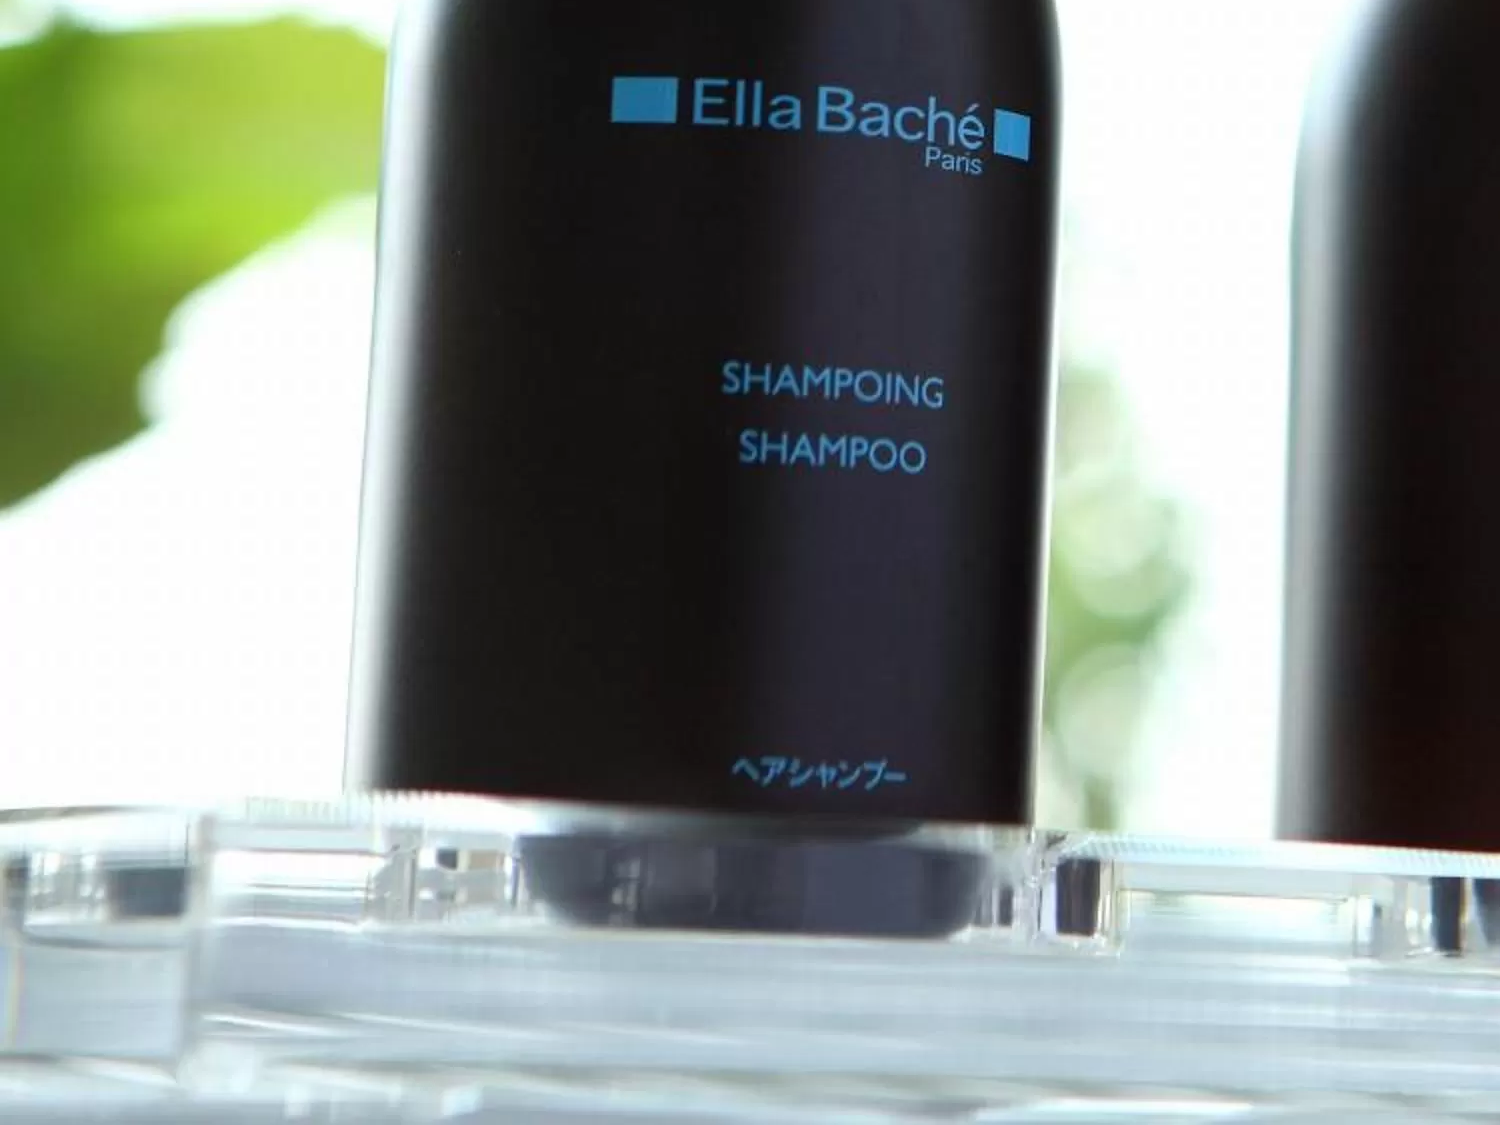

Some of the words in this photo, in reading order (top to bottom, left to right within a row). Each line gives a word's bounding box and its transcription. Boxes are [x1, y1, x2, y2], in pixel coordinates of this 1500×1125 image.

[692, 77, 802, 131] Ella
[816, 84, 986, 151] Baché
[924, 145, 984, 175] Paris
[720, 359, 945, 410] SHAMPOING
[738, 428, 927, 475] SHAMPOO
[730, 755, 907, 791] ヘアシャンプー
